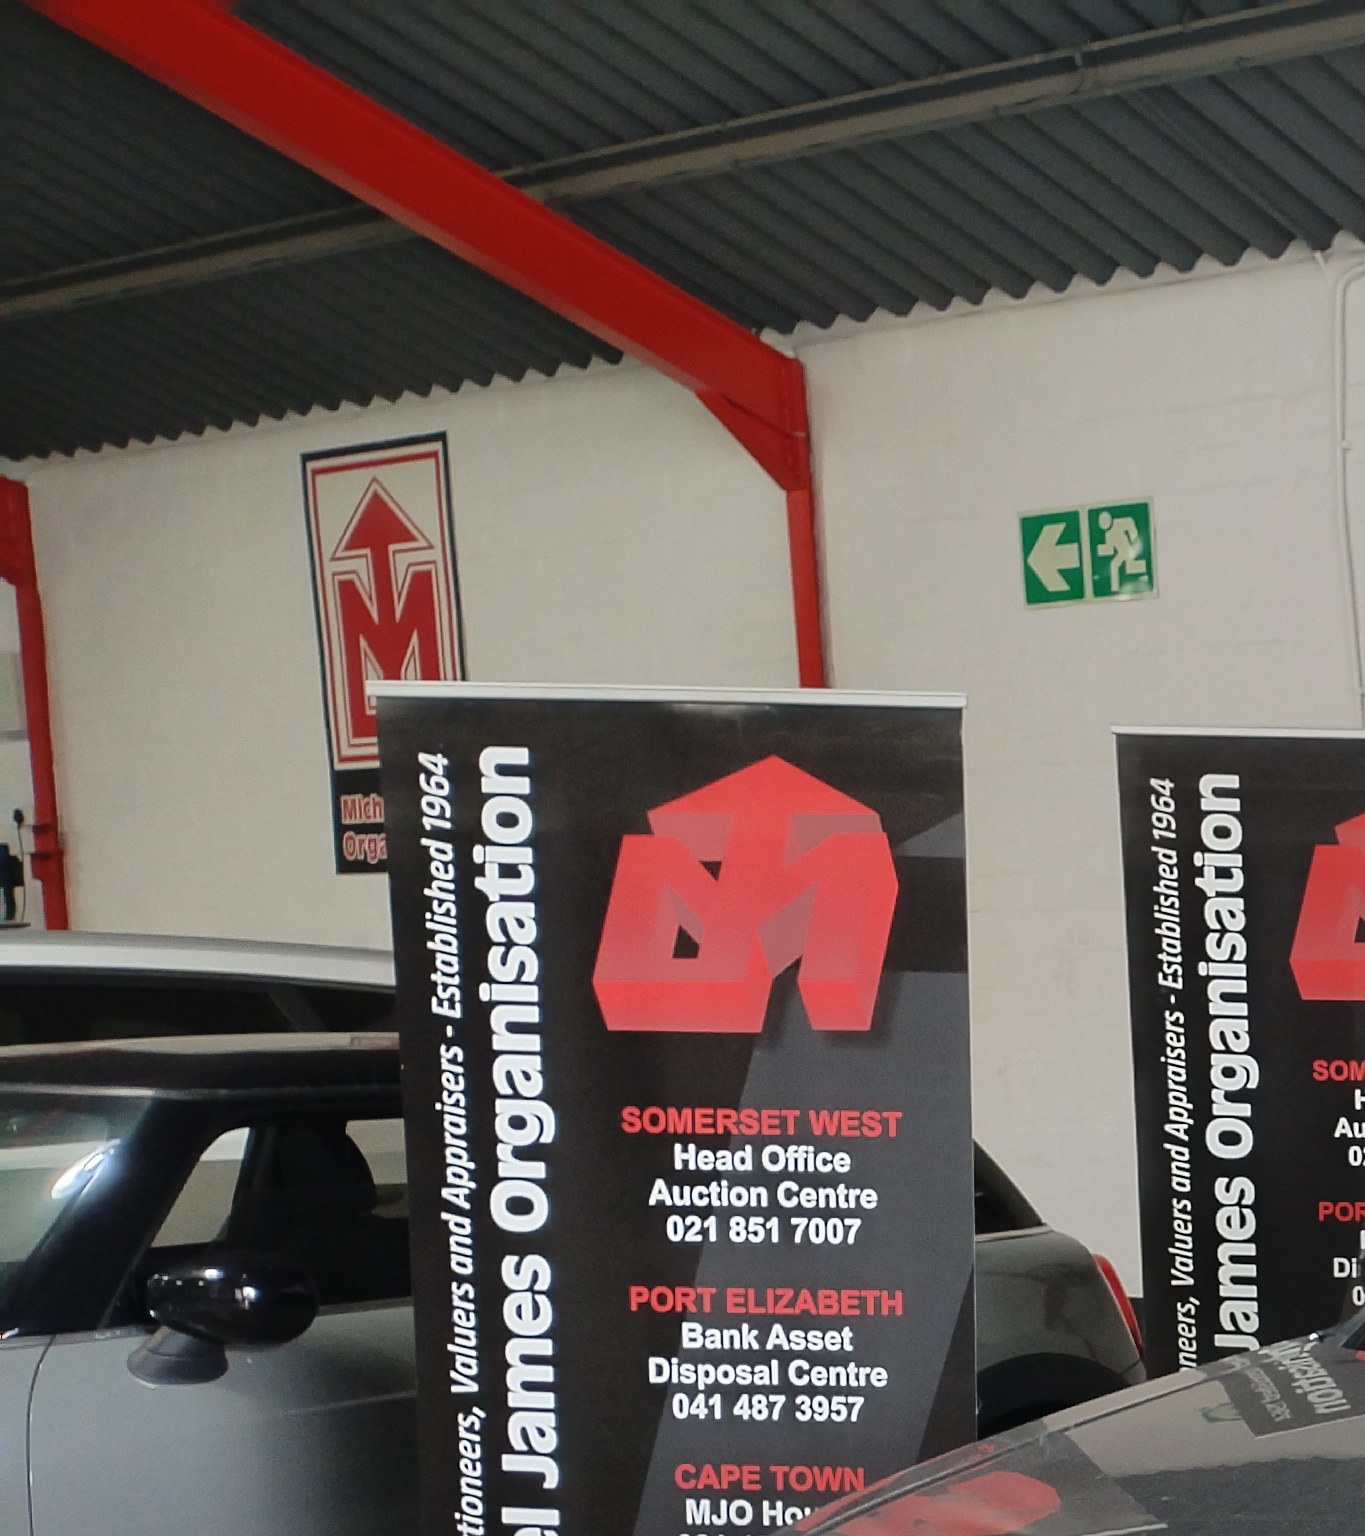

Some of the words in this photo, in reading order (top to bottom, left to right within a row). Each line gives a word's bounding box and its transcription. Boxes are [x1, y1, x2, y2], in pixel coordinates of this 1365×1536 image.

[340, 793, 385, 825] Mich
[418, 752, 451, 831] 1964
[1150, 777, 1176, 841] 1964
[422, 838, 463, 1019] Established
[1151, 846, 1184, 990] Established
[472, 746, 556, 1233] Organisation
[1193, 773, 1260, 1159] Organisation
[1160, 1011, 1194, 1141] Appraisers
[434, 1044, 476, 1210] Appraisers
[621, 1106, 801, 1136] SOMERSET
[809, 1110, 903, 1138] WEST
[674, 1144, 753, 1172] Head
[761, 1144, 852, 1173] Office
[1163, 1143, 1191, 1193] and
[649, 1180, 769, 1208] Auction
[777, 1180, 879, 1210] Centre
[441, 1212, 474, 1275] and
[666, 1215, 719, 1243] 021
[729, 1216, 780, 1244] 851
[790, 1216, 862, 1245] 7007
[1168, 1198, 1195, 1286] Valuers
[1214, 1176, 1260, 1351] James
[629, 1286, 716, 1313] PORT
[726, 1287, 904, 1316] ELIZABETH
[447, 1281, 479, 1394] Valuers
[682, 1322, 761, 1350] Bank
[766, 1324, 854, 1351] Asset
[501, 1254, 560, 1490] James
[648, 1358, 780, 1391] Disposal
[787, 1360, 889, 1388] Centre
[672, 1394, 722, 1421] 041
[733, 1395, 787, 1421] 487
[794, 1395, 865, 1422] 3957
[674, 1463, 762, 1491] CAPE
[769, 1465, 866, 1492] TOWN
[685, 1498, 754, 1526] MJO
